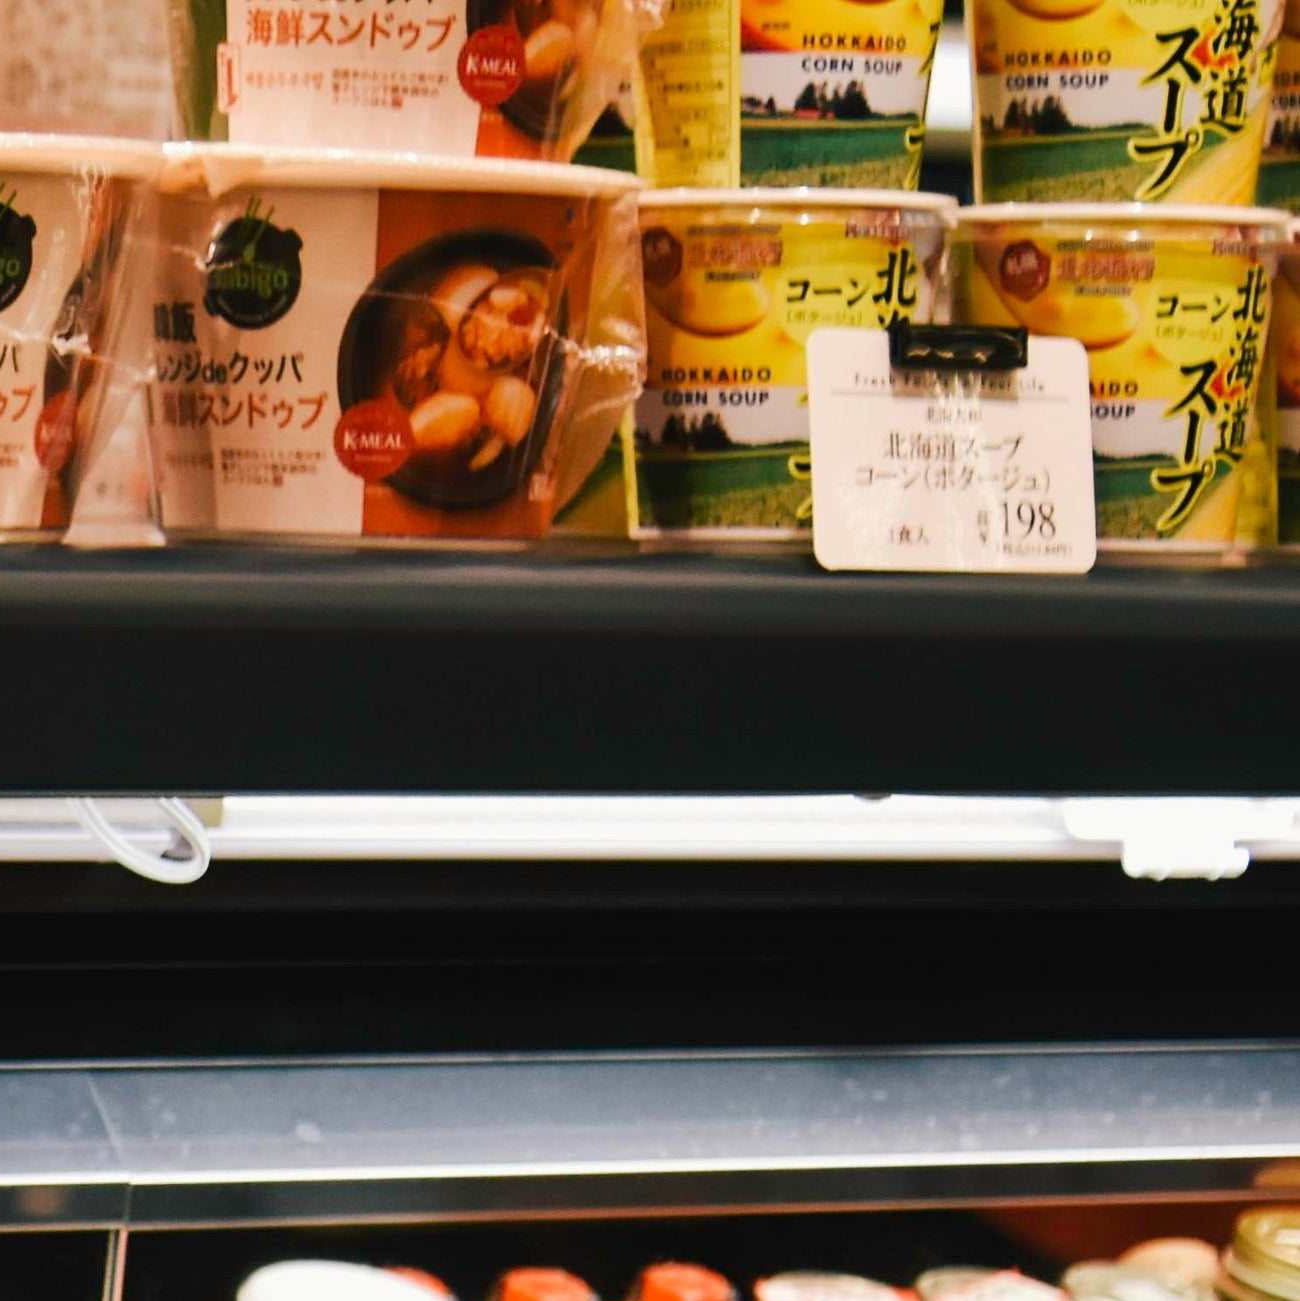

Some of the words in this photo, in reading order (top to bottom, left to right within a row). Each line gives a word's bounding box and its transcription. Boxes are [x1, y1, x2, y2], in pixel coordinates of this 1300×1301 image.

[802, 32, 908, 51] HOKKAIDO
[801, 57, 855, 73] CORN
[863, 58, 904, 76] SOUP
[1004, 48, 1112, 68] HOKKAIDO
[1006, 72, 1049, 90] CORN
[1059, 73, 1110, 89] SOUP
[786, 278, 869, 306] コーン
[1156, 296, 1232, 324] コーン
[662, 366, 772, 384] HOKKAIDO
[663, 390, 708, 407] CORN
[718, 390, 770, 407] SOUP
[1002, 501, 1057, 541] 198
